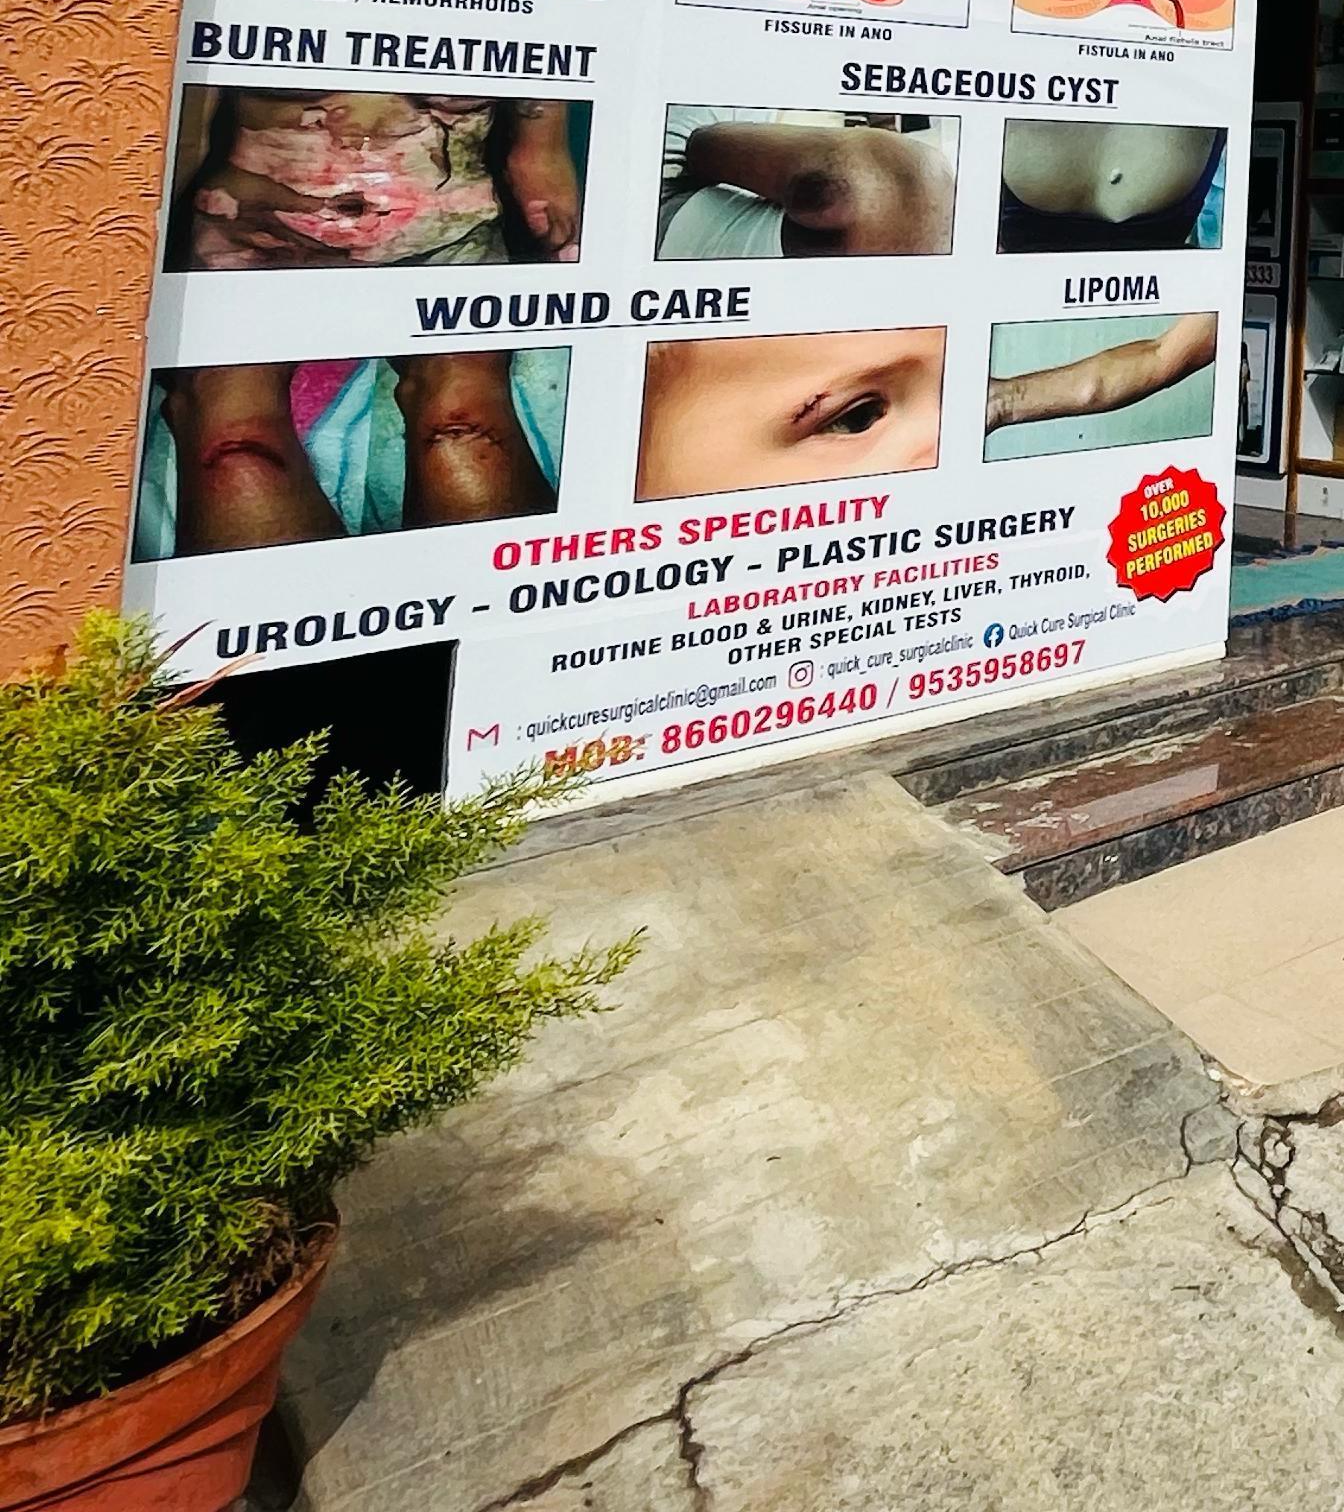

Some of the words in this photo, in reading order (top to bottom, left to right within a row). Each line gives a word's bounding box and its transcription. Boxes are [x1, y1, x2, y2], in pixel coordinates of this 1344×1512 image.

[191, 21, 327, 64] BURN
[344, 31, 598, 77] TREATMENT
[764, 19, 834, 37] FISSURE
[860, 25, 892, 41] ANO
[1078, 44, 1130, 60] FISTULA
[1150, 48, 1175, 63] ANO
[840, 62, 1036, 100] SEBACEOUS
[1047, 74, 1119, 104] CYST
[416, 291, 611, 331] WOUND
[630, 285, 751, 322] CARE
[1063, 274, 1161, 303] LIPOMA
[1139, 490, 1190, 522] 10,000
[1144, 478, 1175, 499] OVER
[492, 524, 663, 571] OTHERS
[678, 494, 891, 548] SPECIALITY
[1127, 508, 1208, 553] SURGERIES
[1125, 531, 1214, 580] PERFORMED
[216, 595, 457, 659] UROLOGY
[509, 555, 734, 614] ONCOLOGY
[776, 528, 923, 576] PLASTIC
[934, 506, 1077, 550] SURGERY
[688, 574, 866, 622] LABORATORY
[873, 552, 1000, 589] FACILITIES
[551, 637, 663, 673] ROUTINE
[670, 621, 749, 652] BLOOD
[782, 604, 854, 631] URINE,
[861, 589, 937, 619] KIDNEY,
[942, 579, 1005, 604] LIVER,
[1009, 563, 1092, 593] THYROID,
[728, 637, 802, 666] OTHER
[809, 621, 898, 652] SPECIAL
[902, 607, 963, 634] TESTS
[526, 671, 777, 741] quickcuresurgicalclinic@gmail.com
[1008, 619, 1038, 642] Quick
[1040, 615, 1065, 635] Cure
[1066, 605, 1107, 633] Surgical
[1109, 601, 1137, 622] Clinic
[661, 683, 877, 756] 8660296440
[908, 639, 1087, 700] 9535958697
